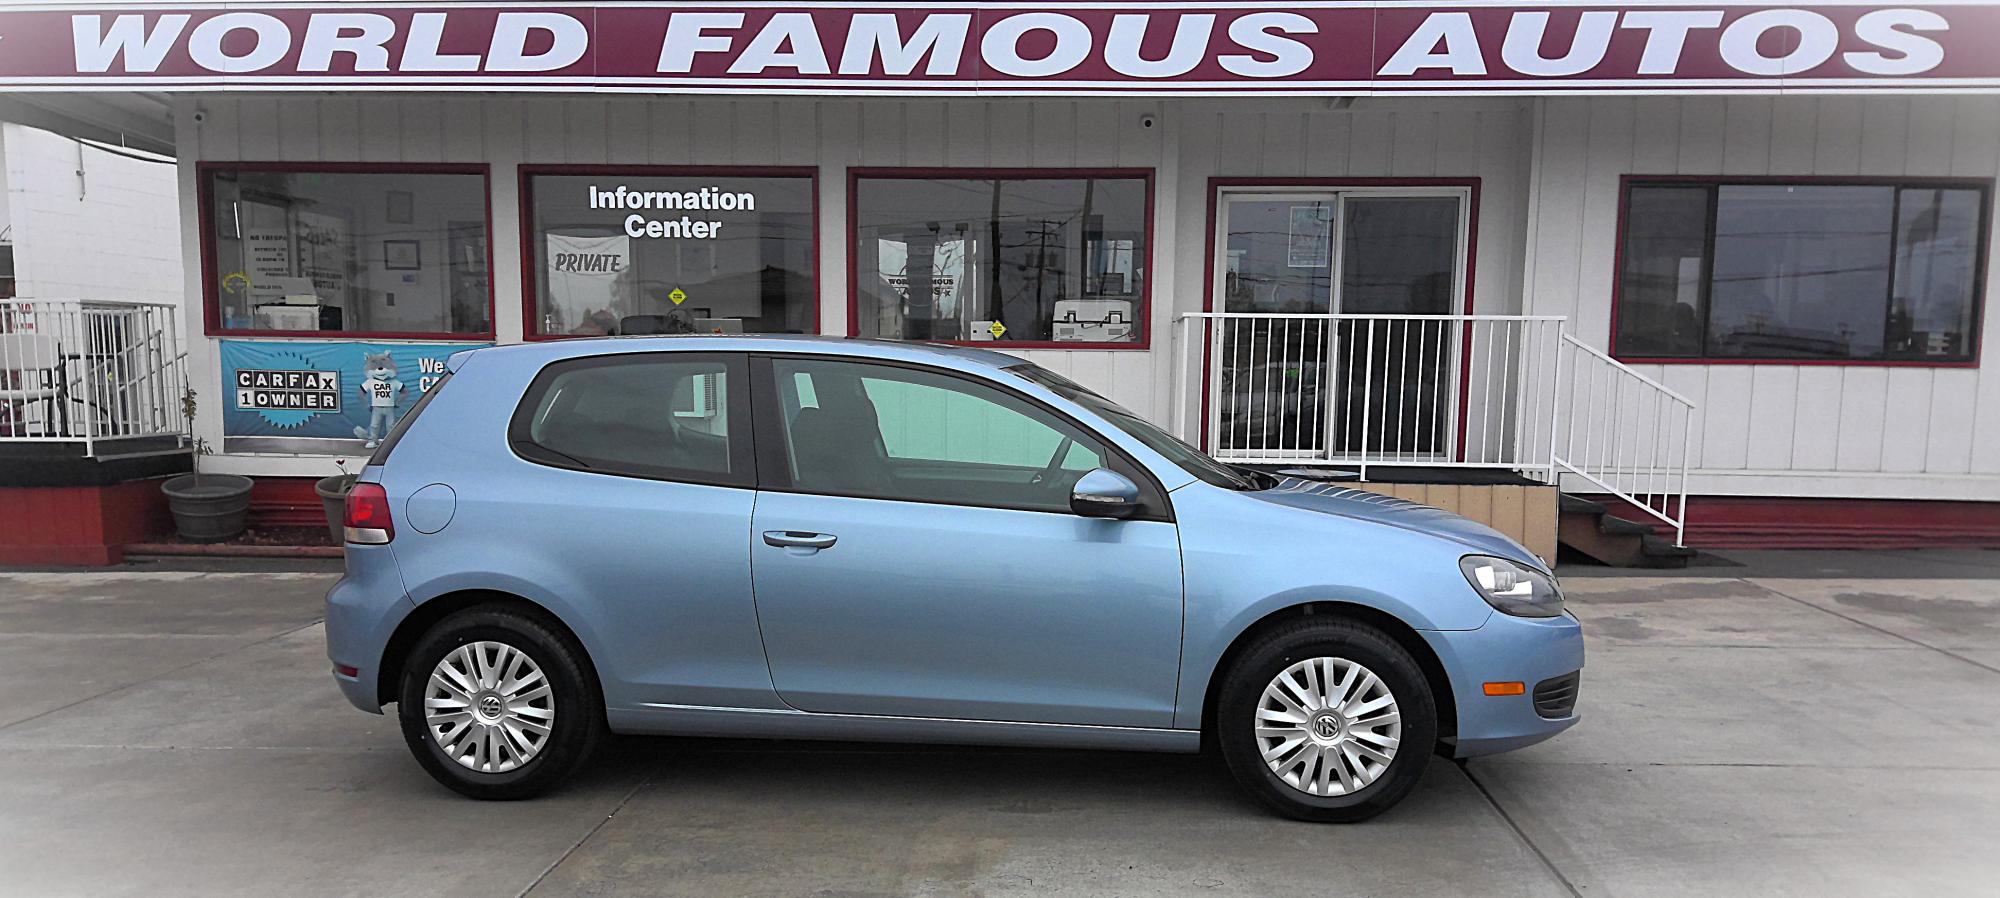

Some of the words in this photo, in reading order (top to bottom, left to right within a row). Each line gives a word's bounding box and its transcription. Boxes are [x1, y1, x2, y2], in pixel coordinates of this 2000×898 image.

[71, 12, 590, 73] WORLD
[656, 11, 1320, 78] FAMOUS
[1376, 8, 1950, 76] AUTOS
[589, 185, 755, 211] Information
[624, 214, 722, 239] Center
[555, 252, 621, 273] PRIVATE
[418, 357, 445, 374] We
[239, 372, 334, 390] CARFAX
[373, 383, 391, 391] CAR
[375, 391, 391, 399] FOX
